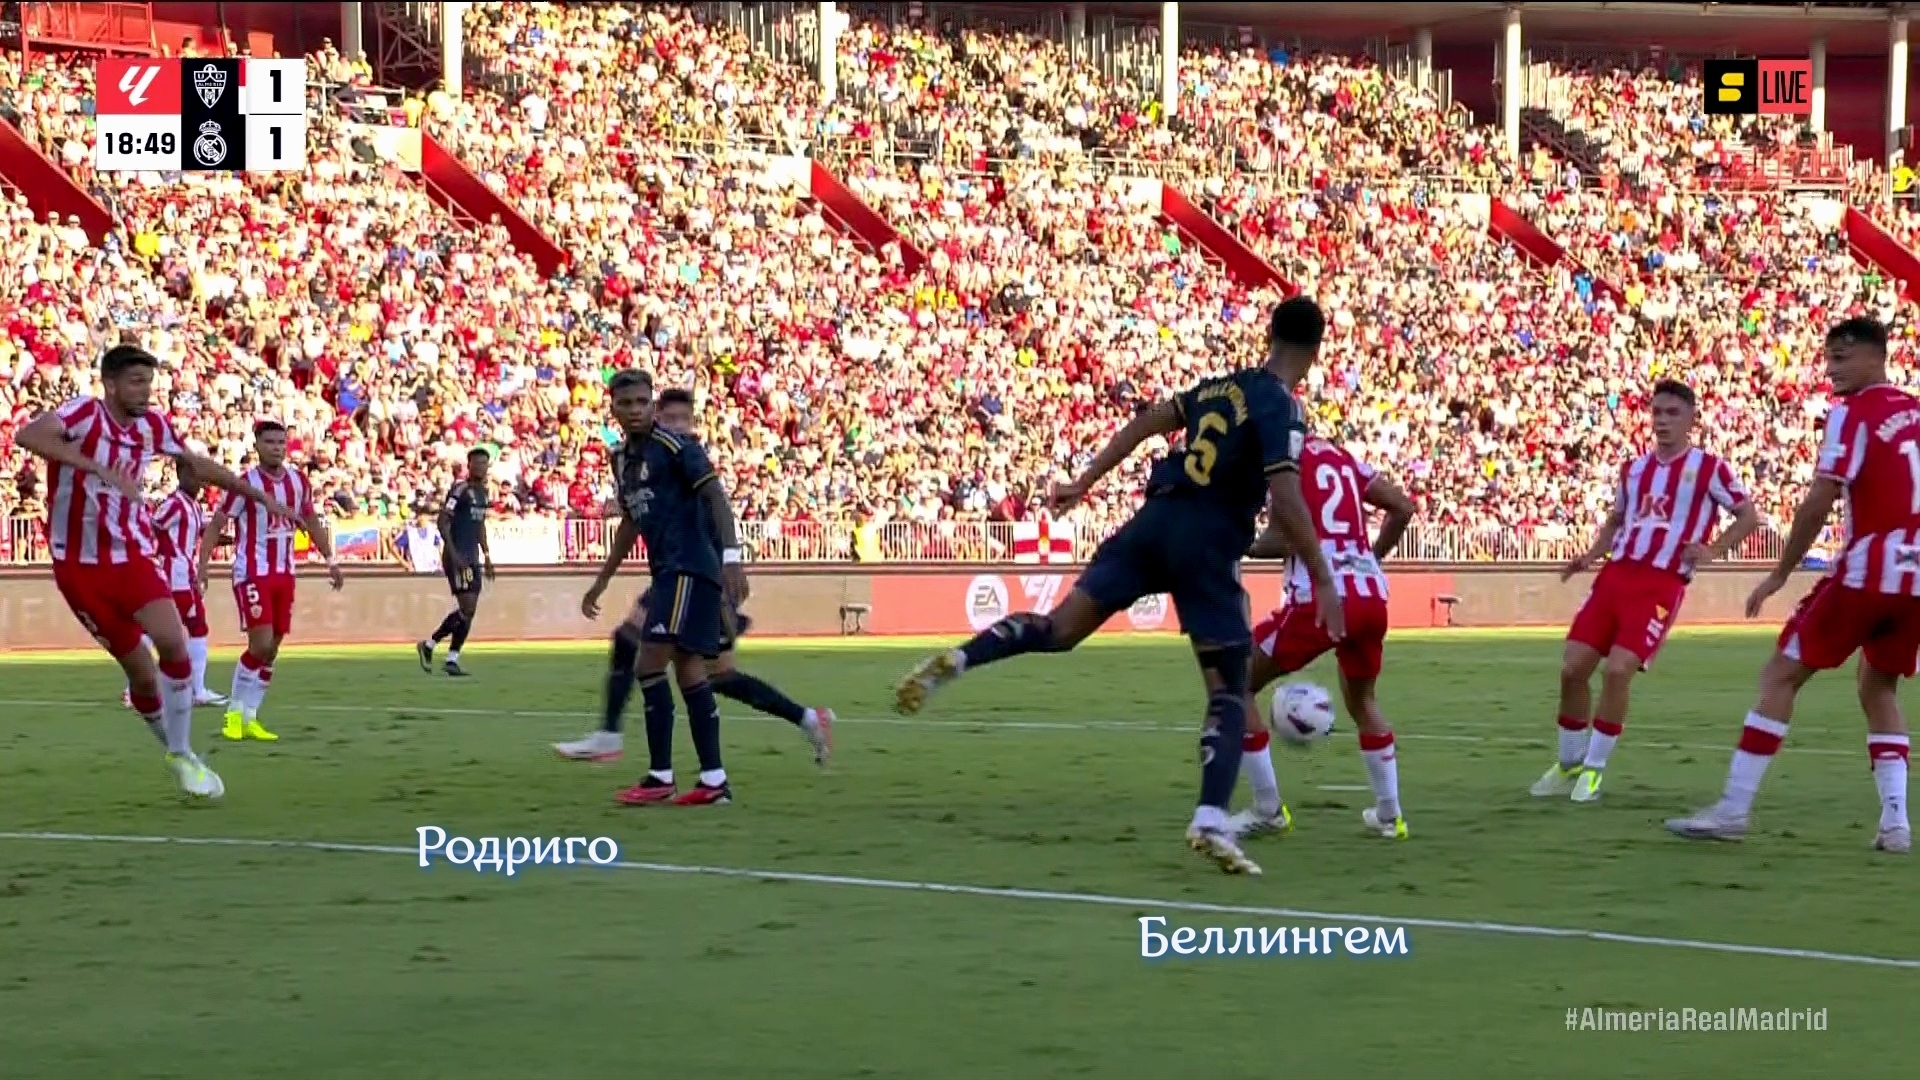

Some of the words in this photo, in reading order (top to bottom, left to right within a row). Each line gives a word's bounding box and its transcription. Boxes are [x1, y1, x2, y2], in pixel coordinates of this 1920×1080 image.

[1184, 411, 1228, 486] 5
[1316, 463, 1363, 537] 21
[246, 583, 259, 603] 5
[974, 585, 1000, 606] EA
